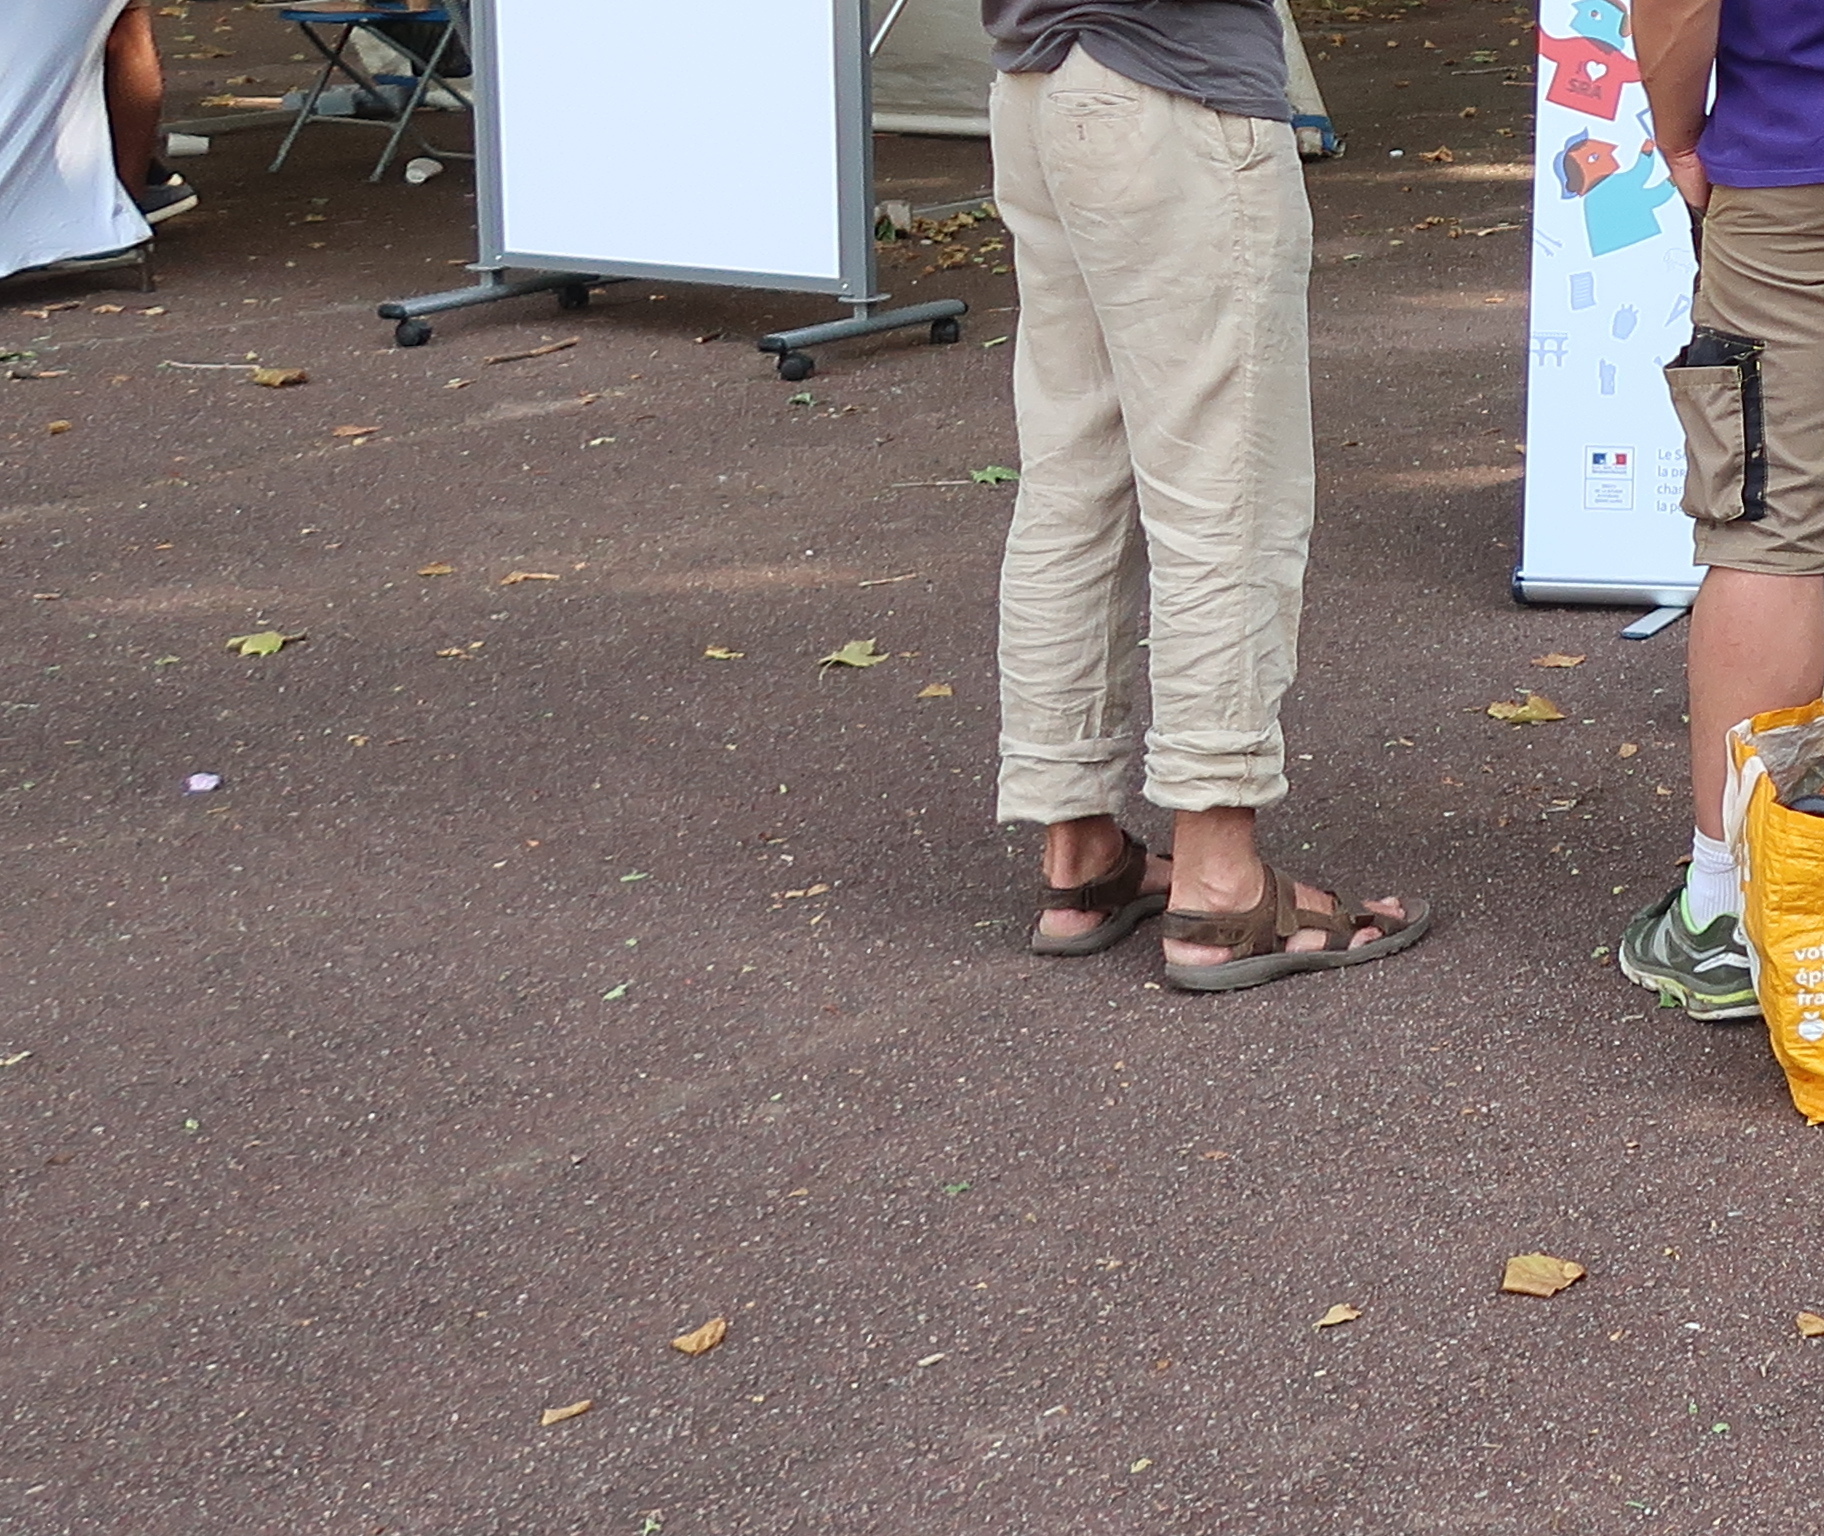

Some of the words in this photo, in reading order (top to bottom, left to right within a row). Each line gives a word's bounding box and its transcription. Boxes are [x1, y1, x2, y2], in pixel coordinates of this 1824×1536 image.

[1658, 449, 1672, 461] Le
[1657, 465, 1669, 477] la
[1656, 500, 1667, 512] la
